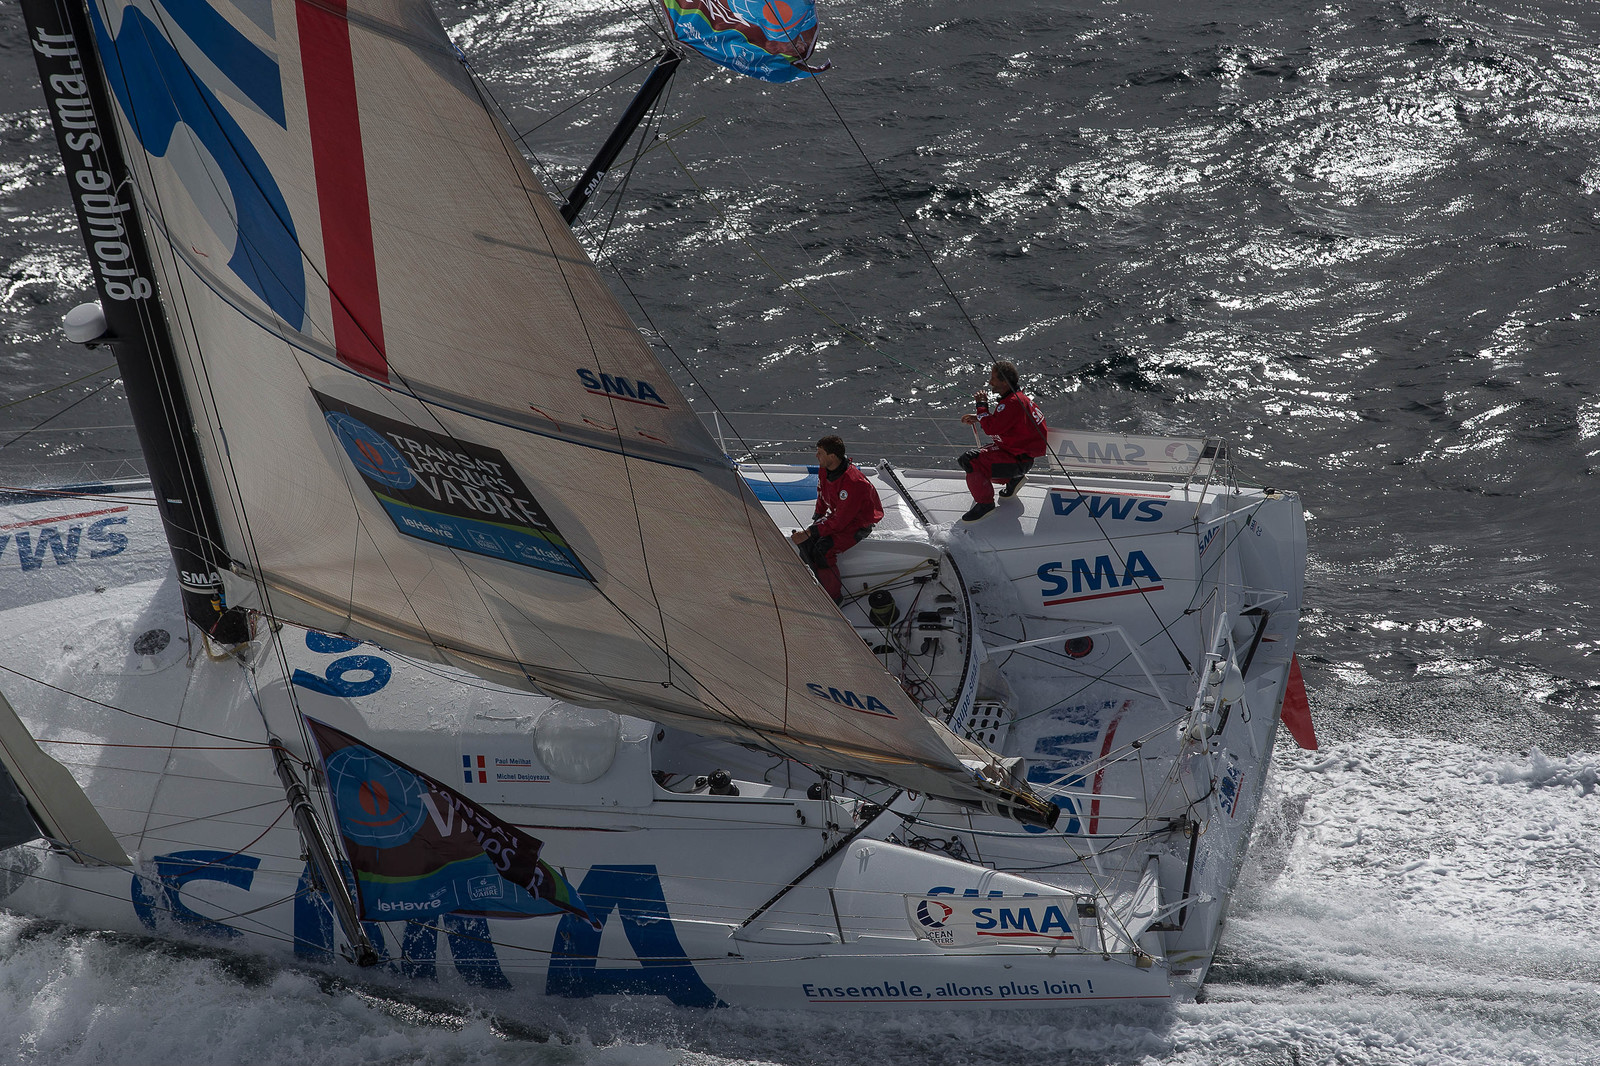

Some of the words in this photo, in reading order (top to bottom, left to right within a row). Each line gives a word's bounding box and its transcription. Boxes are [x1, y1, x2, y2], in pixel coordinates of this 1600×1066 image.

[33, 26, 152, 300] groupe-sma.fr
[584, 171, 605, 198] SMA
[576, 368, 666, 404] SMA
[387, 432, 503, 477] TRANSAT
[403, 466, 547, 527] VABRE
[1050, 492, 1168, 522] SMA
[181, 571, 221, 585] SMA
[1036, 550, 1162, 597] SMA
[807, 683, 895, 716] SMA
[517, 773, 550, 781] Desjoyeaux
[377, 898, 441, 912] leHavre
[972, 906, 1072, 933] SMA
[802, 981, 932, 999] Ensemble,
[936, 982, 994, 998] allons
[999, 981, 1039, 998] plus
[1044, 980, 1081, 996] loin
[1087, 979, 1094, 994] !
